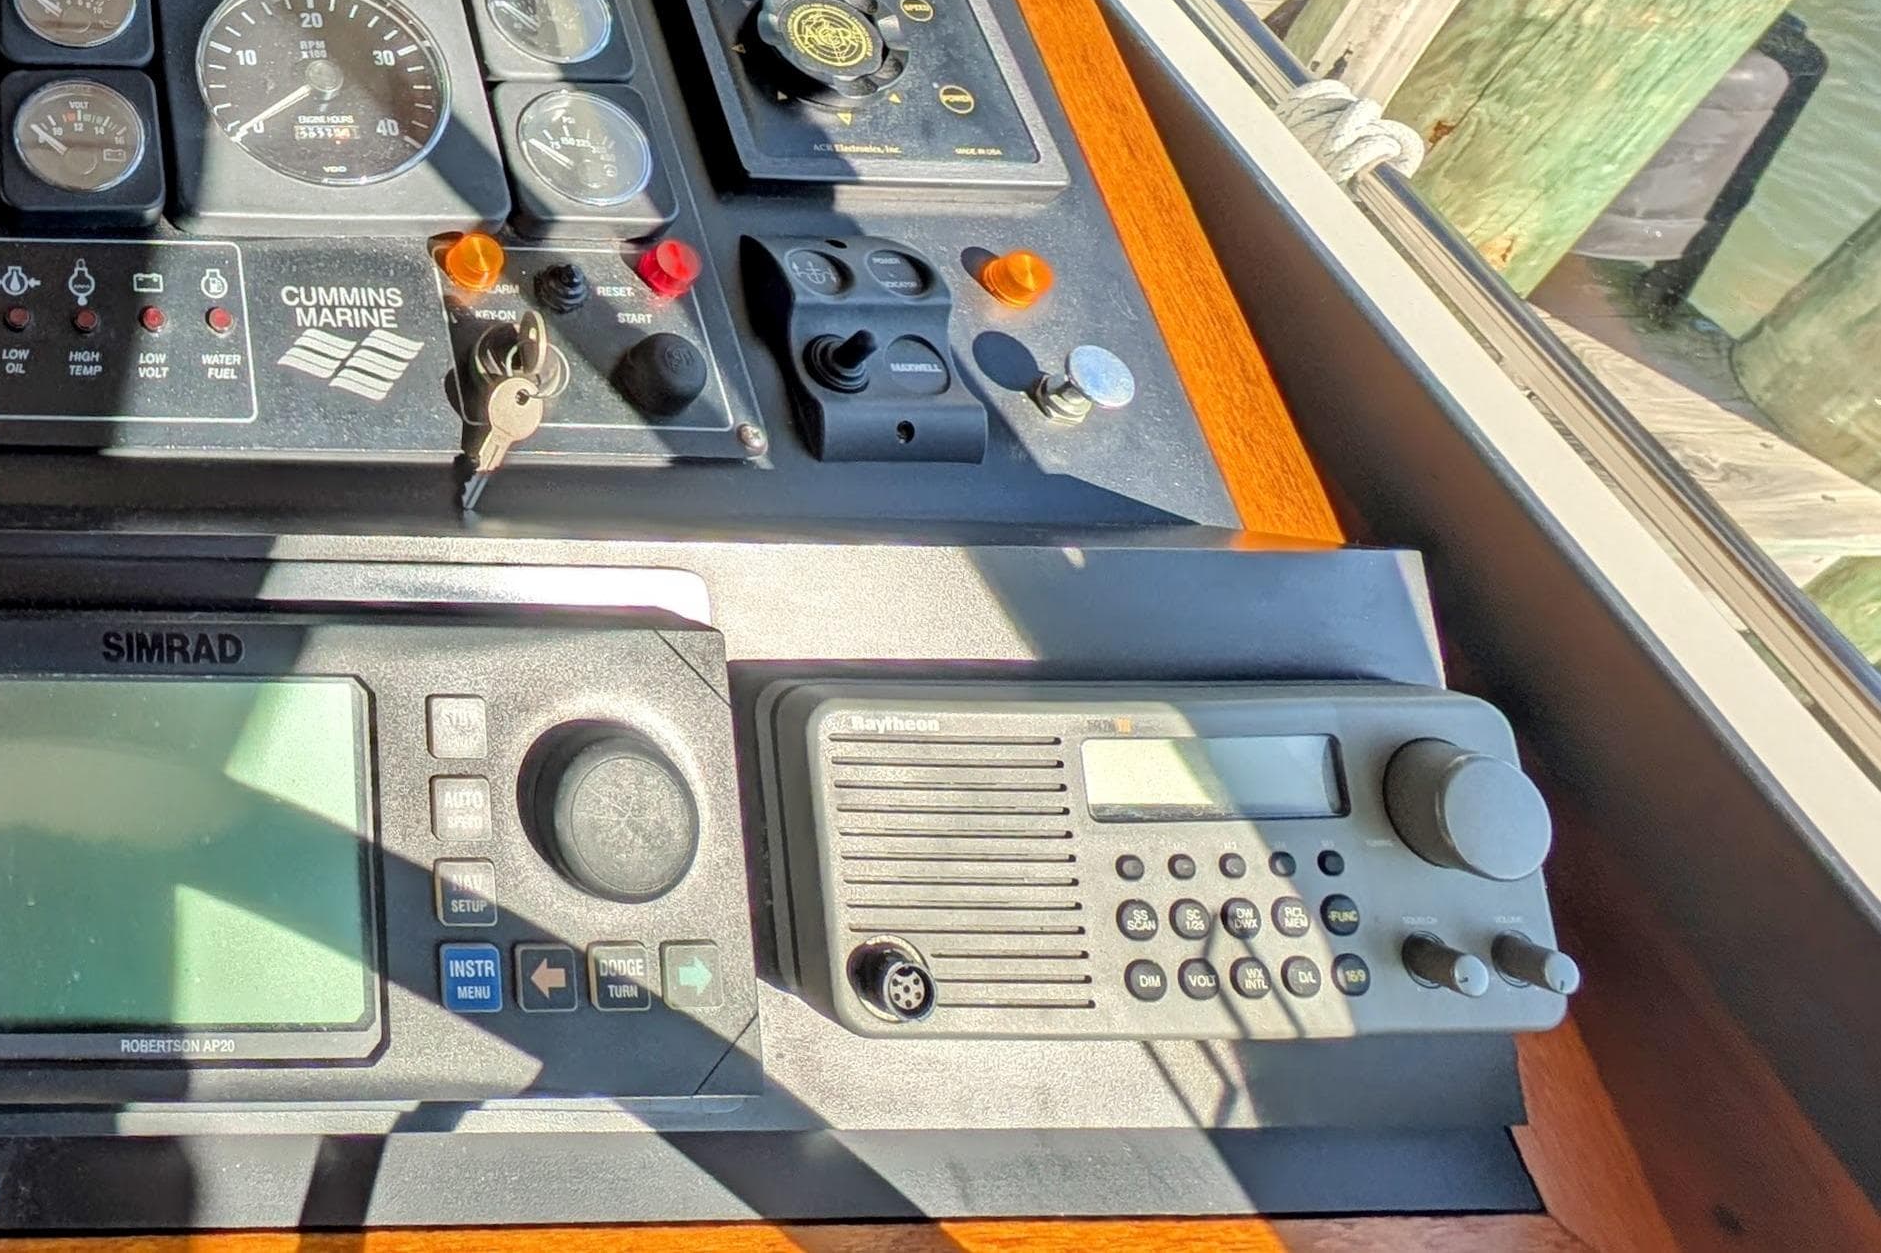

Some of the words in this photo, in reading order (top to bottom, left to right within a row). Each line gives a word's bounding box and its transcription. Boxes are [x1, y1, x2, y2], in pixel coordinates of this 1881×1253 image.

[300, 12, 323, 28] 20
[300, 41, 326, 50] RPM
[236, 50, 257, 66] 10
[372, 49, 396, 66] 30
[69, 101, 88, 109] VOLT
[326, 115, 354, 124] HOURS
[74, 123, 84, 132] 12
[95, 127, 105, 135] 14
[375, 120, 399, 137] 40
[280, 286, 403, 308] CUMMINS
[597, 286, 633, 297] RESET
[295, 308, 398, 328] MARINE
[475, 310, 516, 321] KEY-ON
[617, 312, 652, 324] START
[1, 348, 29, 361] LOW
[69, 351, 100, 363] HIGH
[139, 352, 166, 365] LOW
[202, 354, 241, 366] WATER
[5, 361, 26, 374] OIL
[69, 364, 102, 377] TEMP
[138, 365, 170, 378] VOLT
[207, 367, 238, 379] FUEL
[890, 362, 942, 373] MAXWELL
[102, 631, 245, 664] SIMRAD
[852, 715, 940, 734] Raytheon
[444, 791, 483, 807] AUTO
[452, 873, 483, 891] NAV
[451, 899, 487, 913] SETUP
[1133, 909, 1148, 920] SS
[1186, 909, 1200, 920] SC
[1236, 908, 1254, 919] DW
[1285, 907, 1303, 918] RCL
[1127, 920, 1156, 931] SCAN
[1234, 919, 1258, 929] DWX
[1285, 917, 1309, 928] MEM
[449, 959, 495, 977] INSTR
[599, 959, 643, 976] DODGE
[1246, 968, 1264, 979] WX
[1139, 975, 1161, 987] DIM
[1188, 975, 1216, 987] VOLT
[1345, 969, 1366, 982] 16/9
[1245, 979, 1268, 990] INTL
[457, 986, 491, 999] MENU
[608, 985, 638, 998] TURN
[121, 1039, 200, 1053] ROBERTSON
[203, 1039, 235, 1052] AP20
